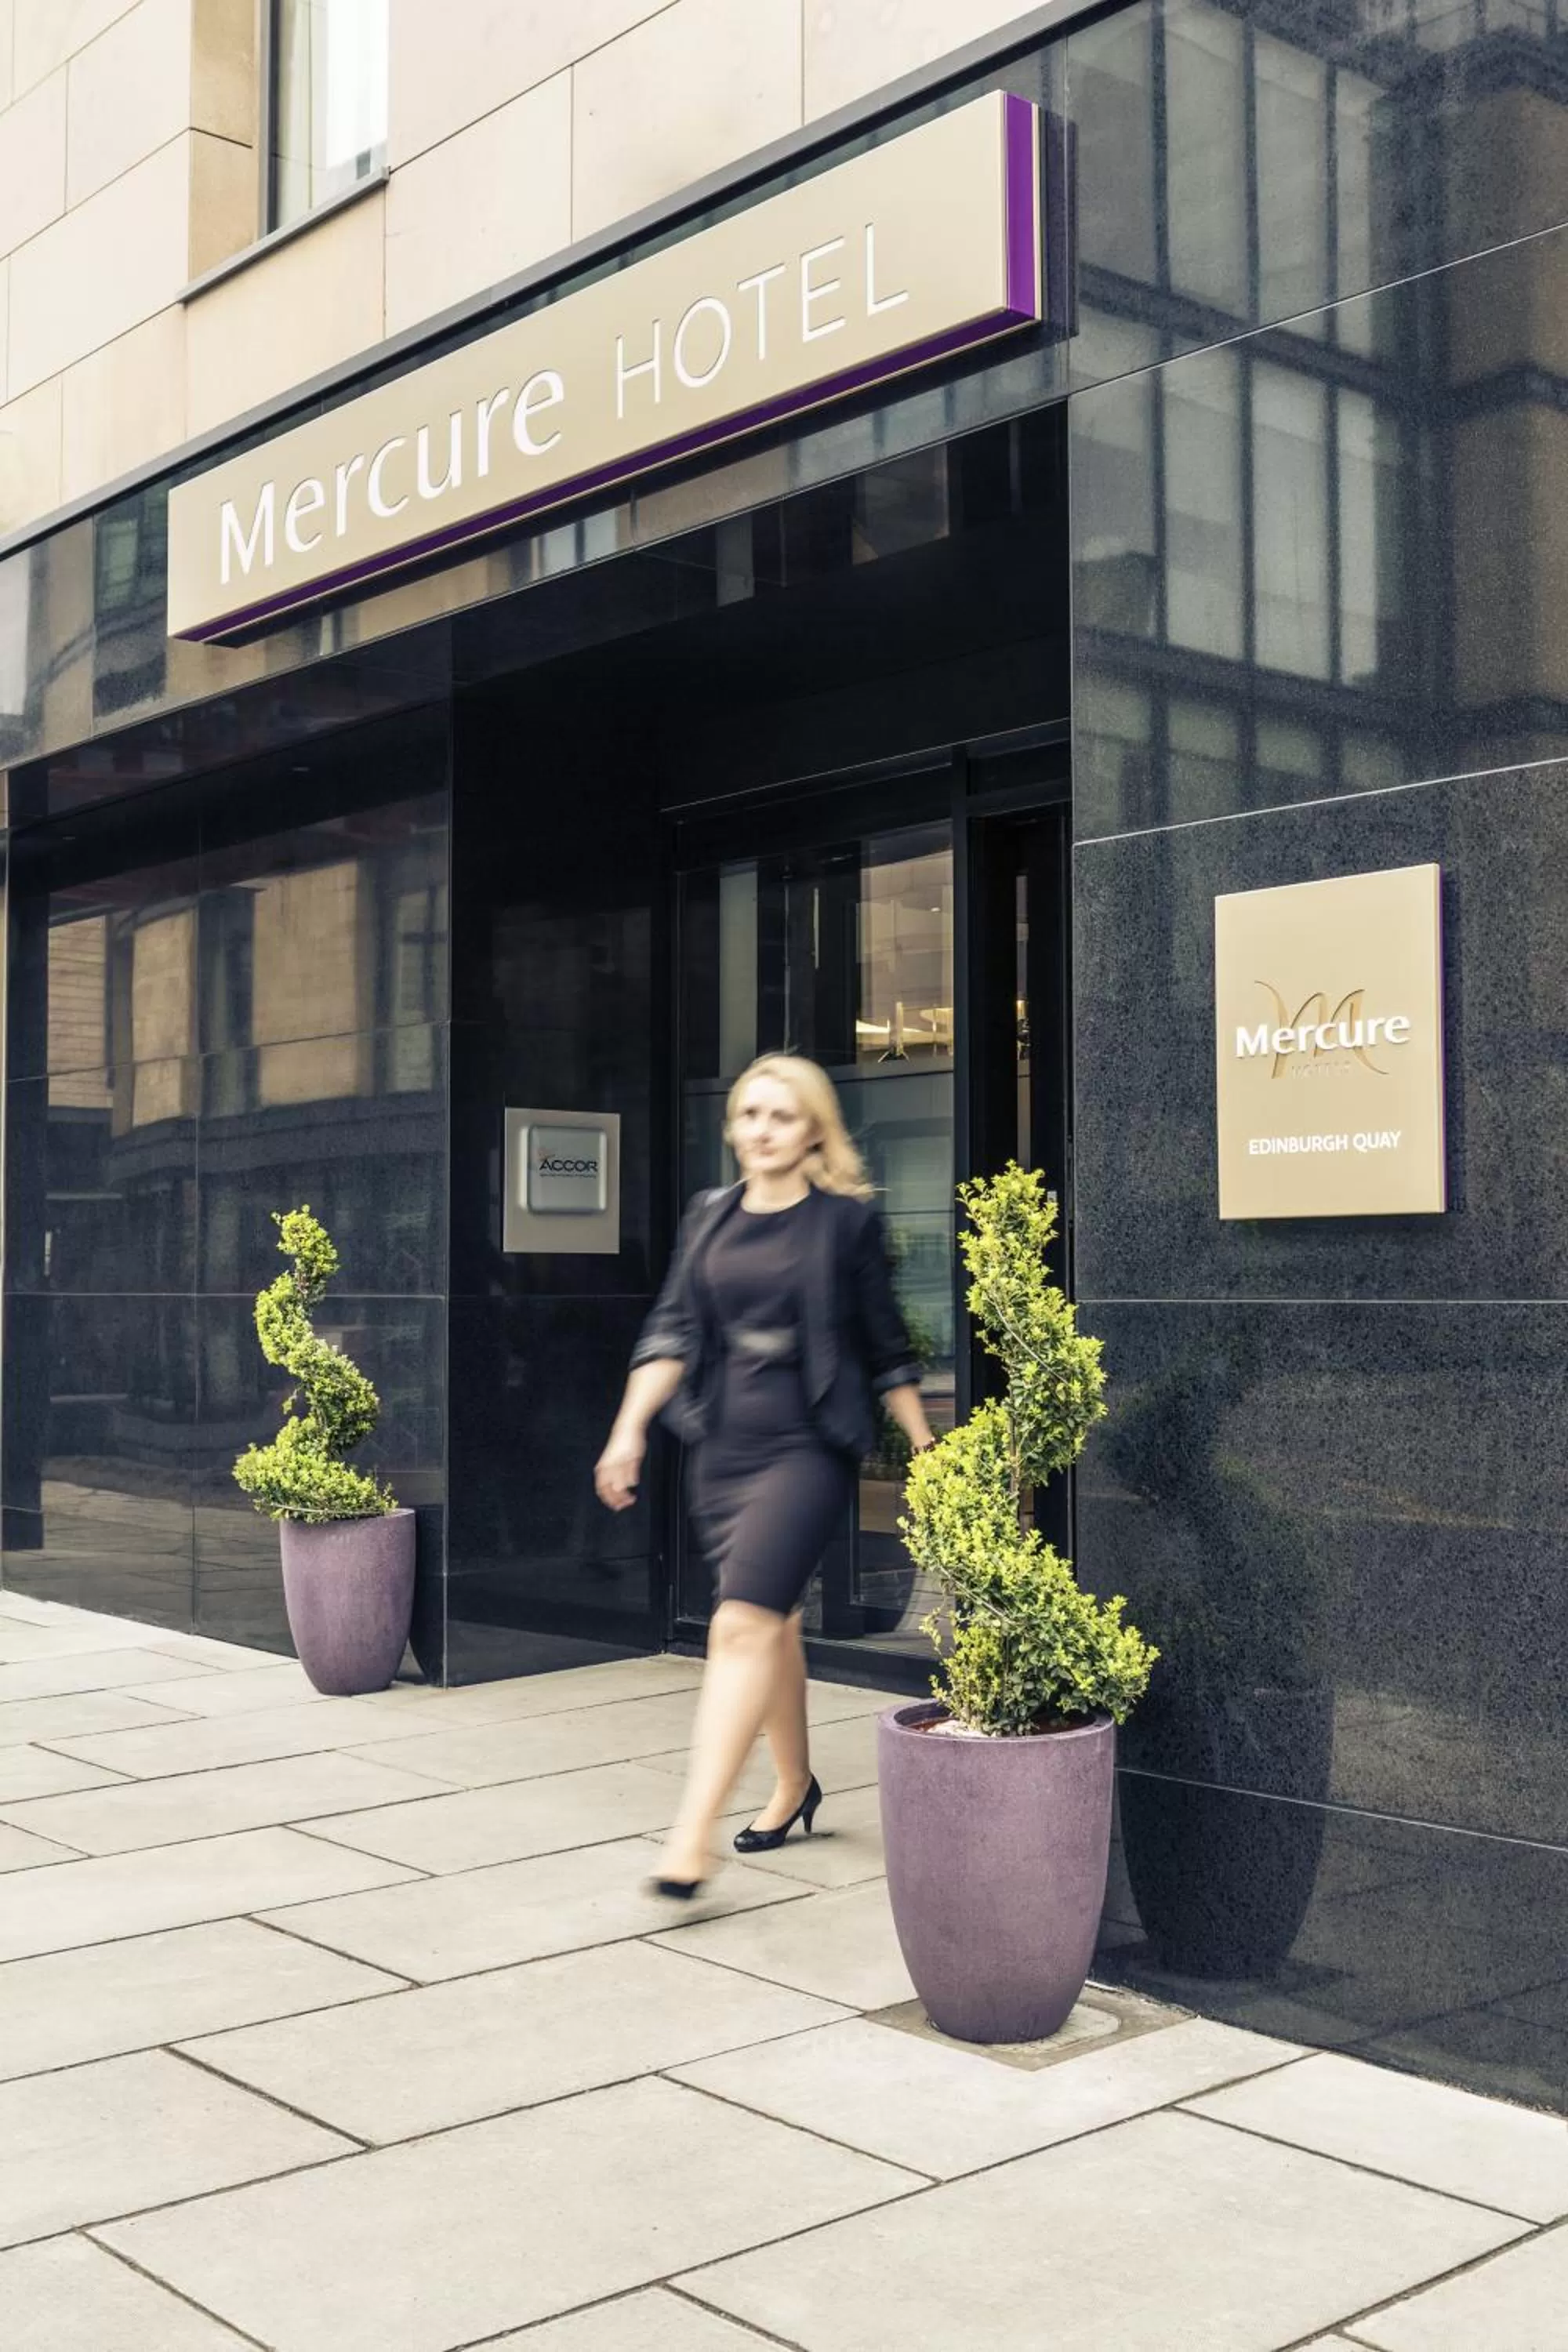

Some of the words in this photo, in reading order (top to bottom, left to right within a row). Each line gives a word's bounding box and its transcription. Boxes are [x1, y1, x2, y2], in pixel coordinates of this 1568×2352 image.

[218, 368, 565, 584] Mercure
[615, 222, 909, 419] HOTEL
[1236, 1014, 1411, 1058] Mercure
[1249, 1134, 1348, 1155] EDINBURGH
[1352, 1130, 1402, 1152] QUAY
[539, 1158, 598, 1172] ACCOR
